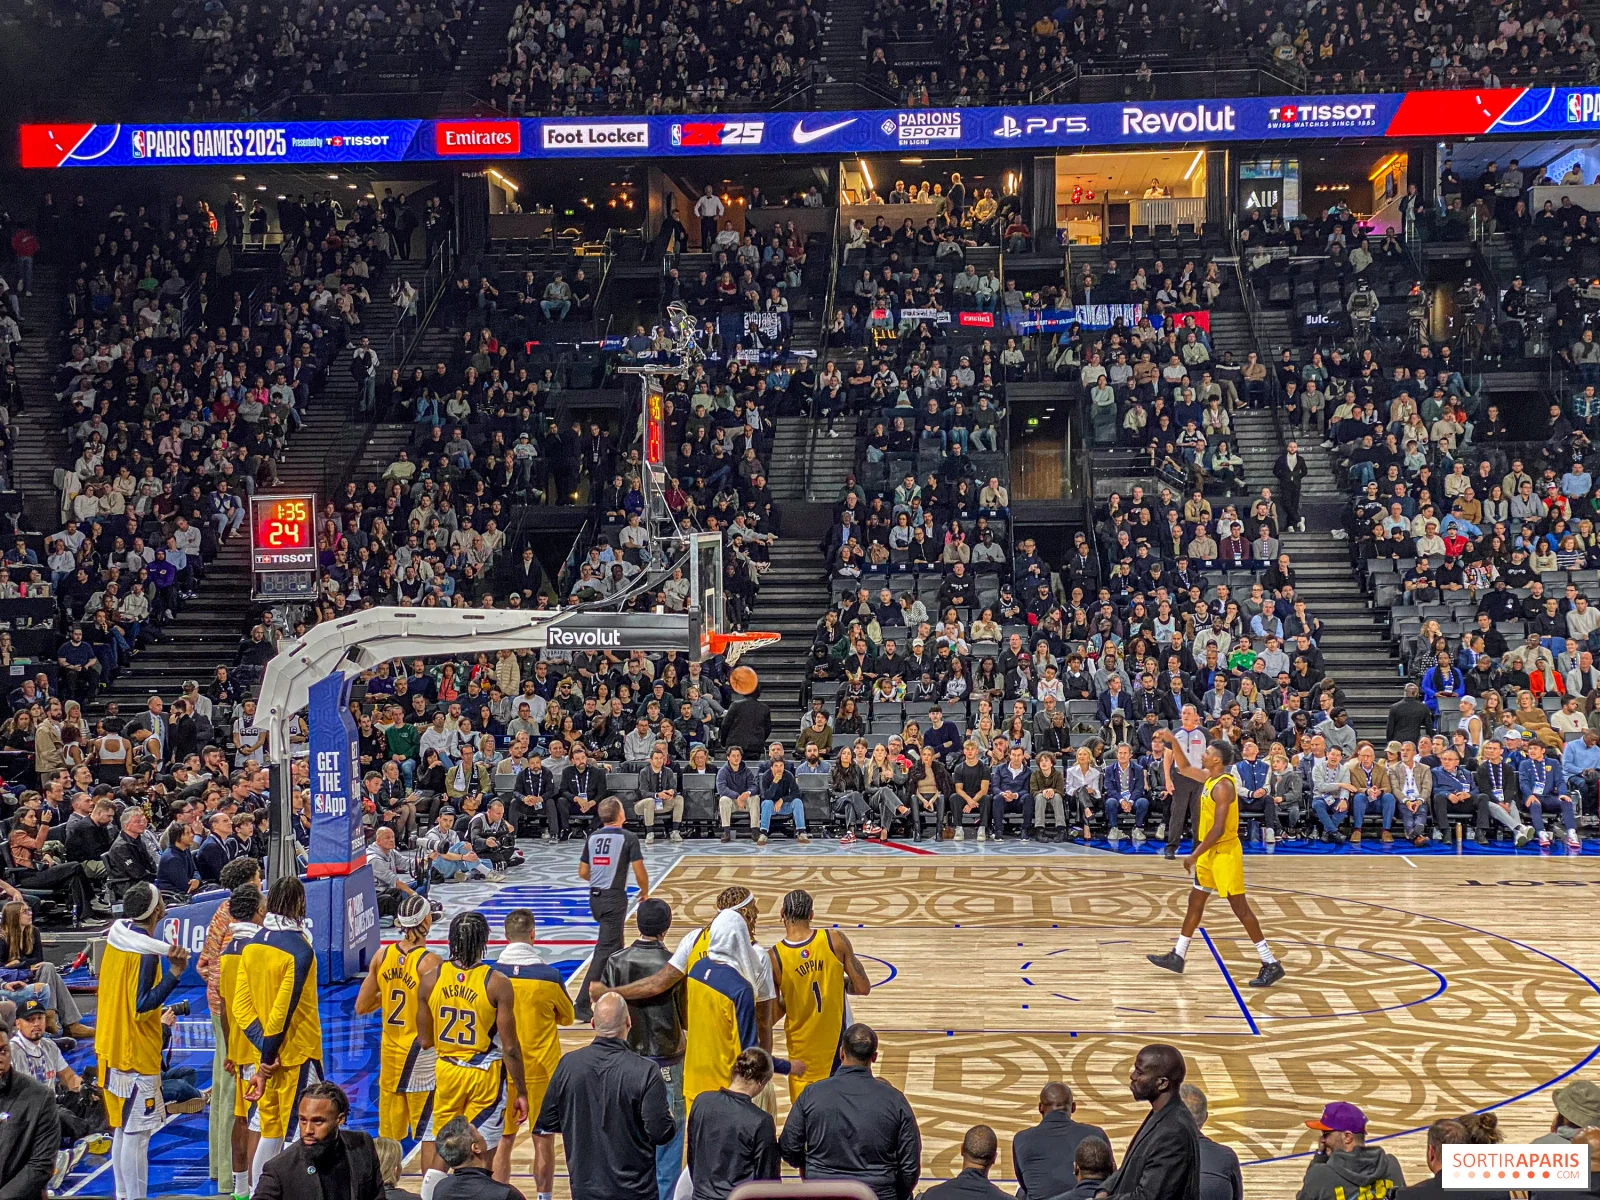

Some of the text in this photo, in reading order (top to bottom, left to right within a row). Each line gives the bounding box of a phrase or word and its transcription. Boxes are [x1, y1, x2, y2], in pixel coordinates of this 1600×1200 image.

[899, 113, 961, 125] PARIONS
[1027, 117, 1087, 134] PS5
[1123, 105, 1235, 134] Revolut
[445, 131, 512, 146] Emirates
[547, 128, 644, 144] Foot Locker
[902, 127, 959, 137] SPORT
[146, 128, 287, 158] PARIS GAMES 2025
[292, 137, 316, 147] Presented
[278, 503, 306, 521] 1:35
[269, 522, 299, 545] 24
[271, 554, 313, 563] TISSOT
[549, 627, 621, 646] Revolut
[317, 751, 340, 771] GET
[318, 772, 342, 792] THE
[325, 794, 347, 817] App
[595, 837, 612, 855] 36
[795, 960, 824, 977] TOPPIN
[441, 984, 479, 1004] NESMITH
[812, 981, 823, 1014] 1
[387, 988, 406, 1026] 2
[438, 1005, 476, 1046] 23
